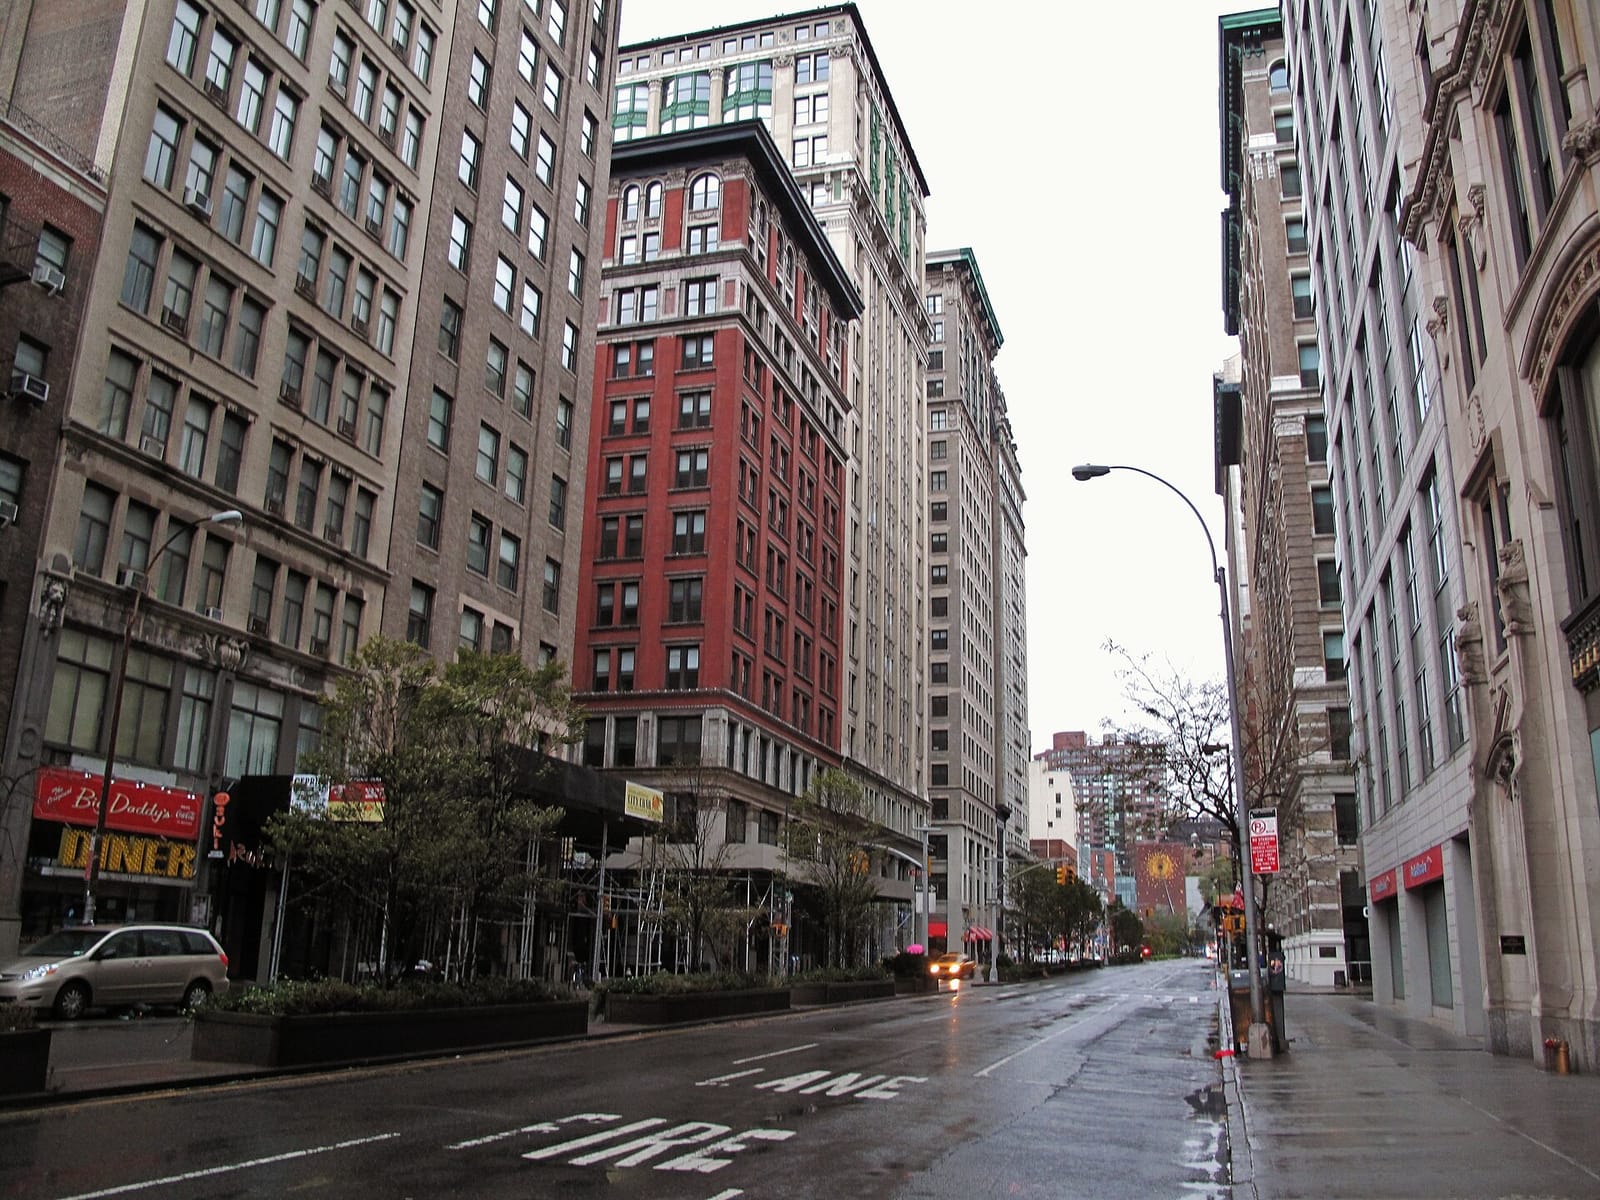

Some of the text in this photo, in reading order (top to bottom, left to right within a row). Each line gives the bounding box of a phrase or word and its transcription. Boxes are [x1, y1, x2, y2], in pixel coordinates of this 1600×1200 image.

[109, 793, 172, 823] Daddy's
[60, 828, 197, 879] DINER
[444, 1112, 797, 1173] FIRE
